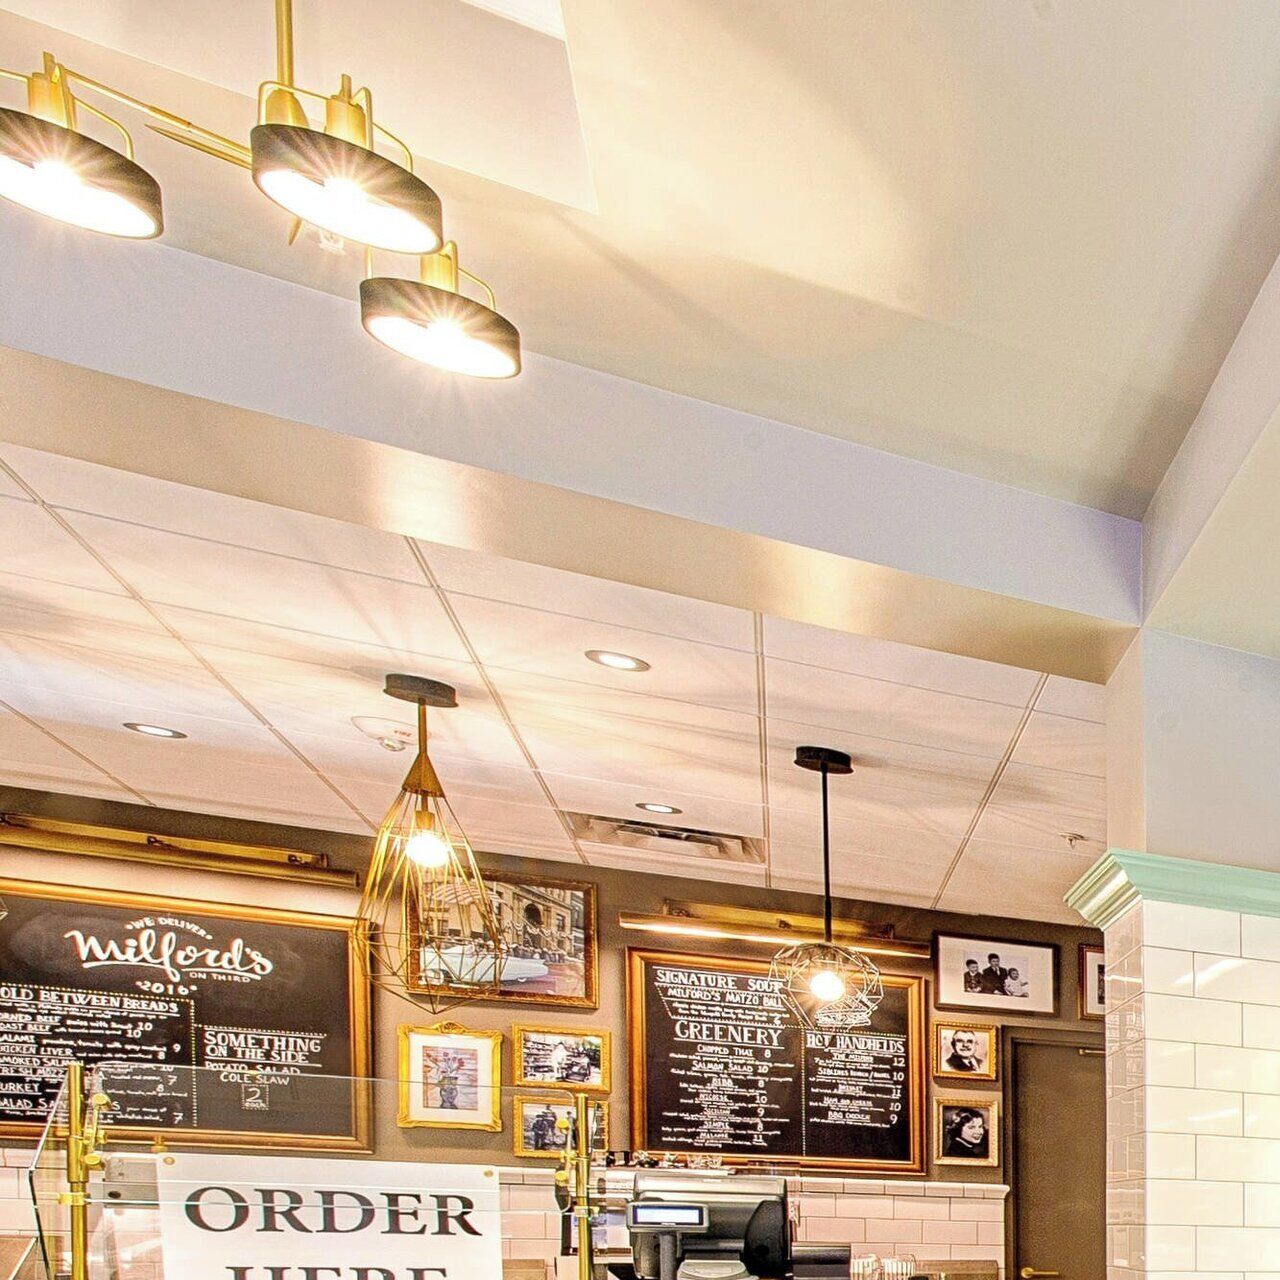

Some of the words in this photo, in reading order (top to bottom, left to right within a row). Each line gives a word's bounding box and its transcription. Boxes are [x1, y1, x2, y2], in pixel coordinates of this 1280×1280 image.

[131, 917, 155, 930] WE
[160, 917, 207, 936] DELIVER
[64, 929, 274, 982] Milford's
[189, 972, 207, 980] ON
[211, 973, 252, 984] THIRD
[656, 970, 737, 990] SIGNATURE
[140, 982, 190, 996] 2016
[40, 990, 120, 1009] BETWEEN
[122, 997, 179, 1013] BREADS
[667, 987, 721, 1003] MILFORD'S
[725, 991, 760, 1005] MATZO
[137, 1022, 153, 1031] 10
[674, 1018, 783, 1047] GREENERY
[126, 1030, 142, 1038] 10
[173, 1043, 181, 1053] 9
[203, 1031, 322, 1053] SOMETHING
[806, 1033, 832, 1048] HOT
[836, 1036, 905, 1053] HANDHELDS
[40, 1047, 74, 1057] LIVER
[157, 1052, 166, 1060] 8
[204, 1044, 226, 1058] ON
[234, 1047, 266, 1061] THE
[271, 1050, 310, 1064] SIDE
[763, 1049, 772, 1058] 8
[204, 1061, 249, 1072] POTATO
[255, 1065, 300, 1076] SALAD
[692, 1061, 724, 1071] SALMON
[728, 1063, 754, 1072] SALAD
[757, 1065, 769, 1073] 10
[893, 1057, 906, 1067] 12
[167, 1075, 178, 1086] 7
[220, 1072, 251, 1084] COLE
[254, 1074, 290, 1086] SLAW
[893, 1072, 905, 1081] 10
[156, 1084, 165, 1093] 8
[245, 1088, 261, 1102] 2
[756, 1096, 768, 1104] 10
[889, 1102, 902, 1111] 10
[173, 1112, 184, 1125] 7
[757, 1107, 765, 1117] 9
[889, 1114, 898, 1125] 9
[184, 1185, 483, 1237] ORDER
